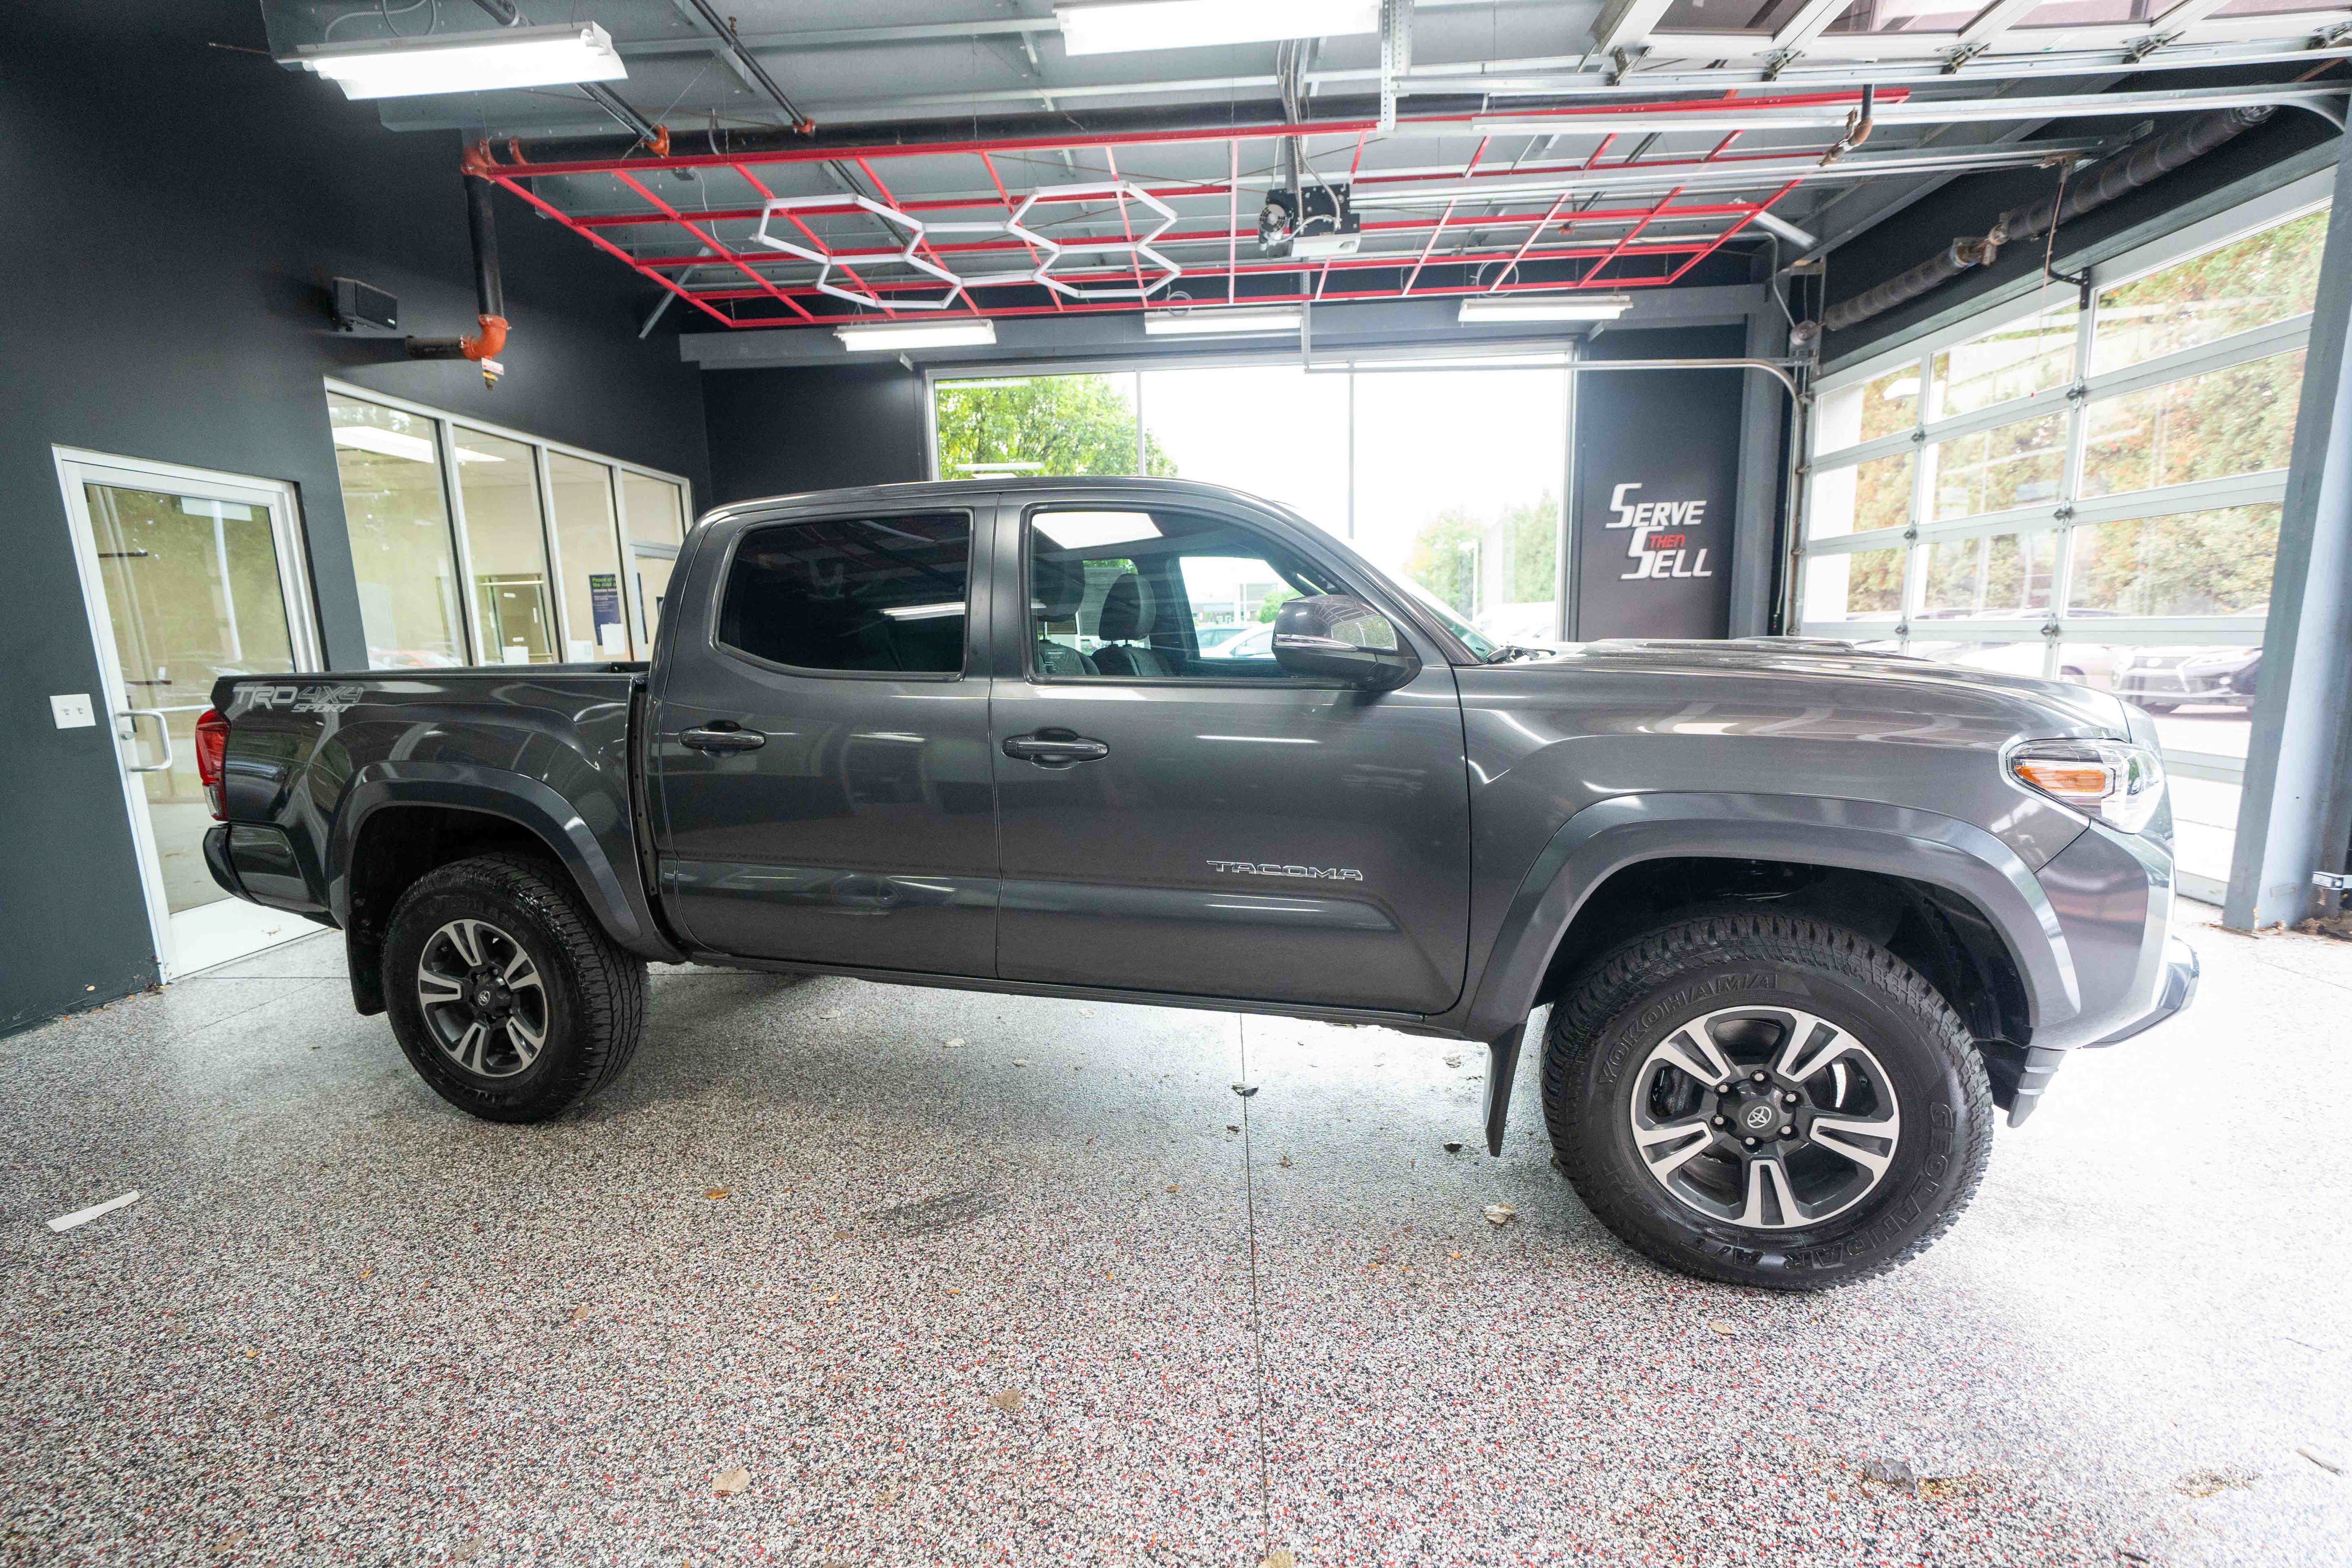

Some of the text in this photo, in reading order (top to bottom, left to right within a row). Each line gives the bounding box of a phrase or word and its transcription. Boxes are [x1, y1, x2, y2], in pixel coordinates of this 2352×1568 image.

[1605, 483, 1707, 528] SERVE
[1621, 526, 1713, 579] SELL
[232, 686, 298, 710] TRD
[291, 703, 356, 713] SPORT
[1206, 860, 1363, 881] TACOMA
[1597, 973, 1778, 1085] YOKOHAMA
